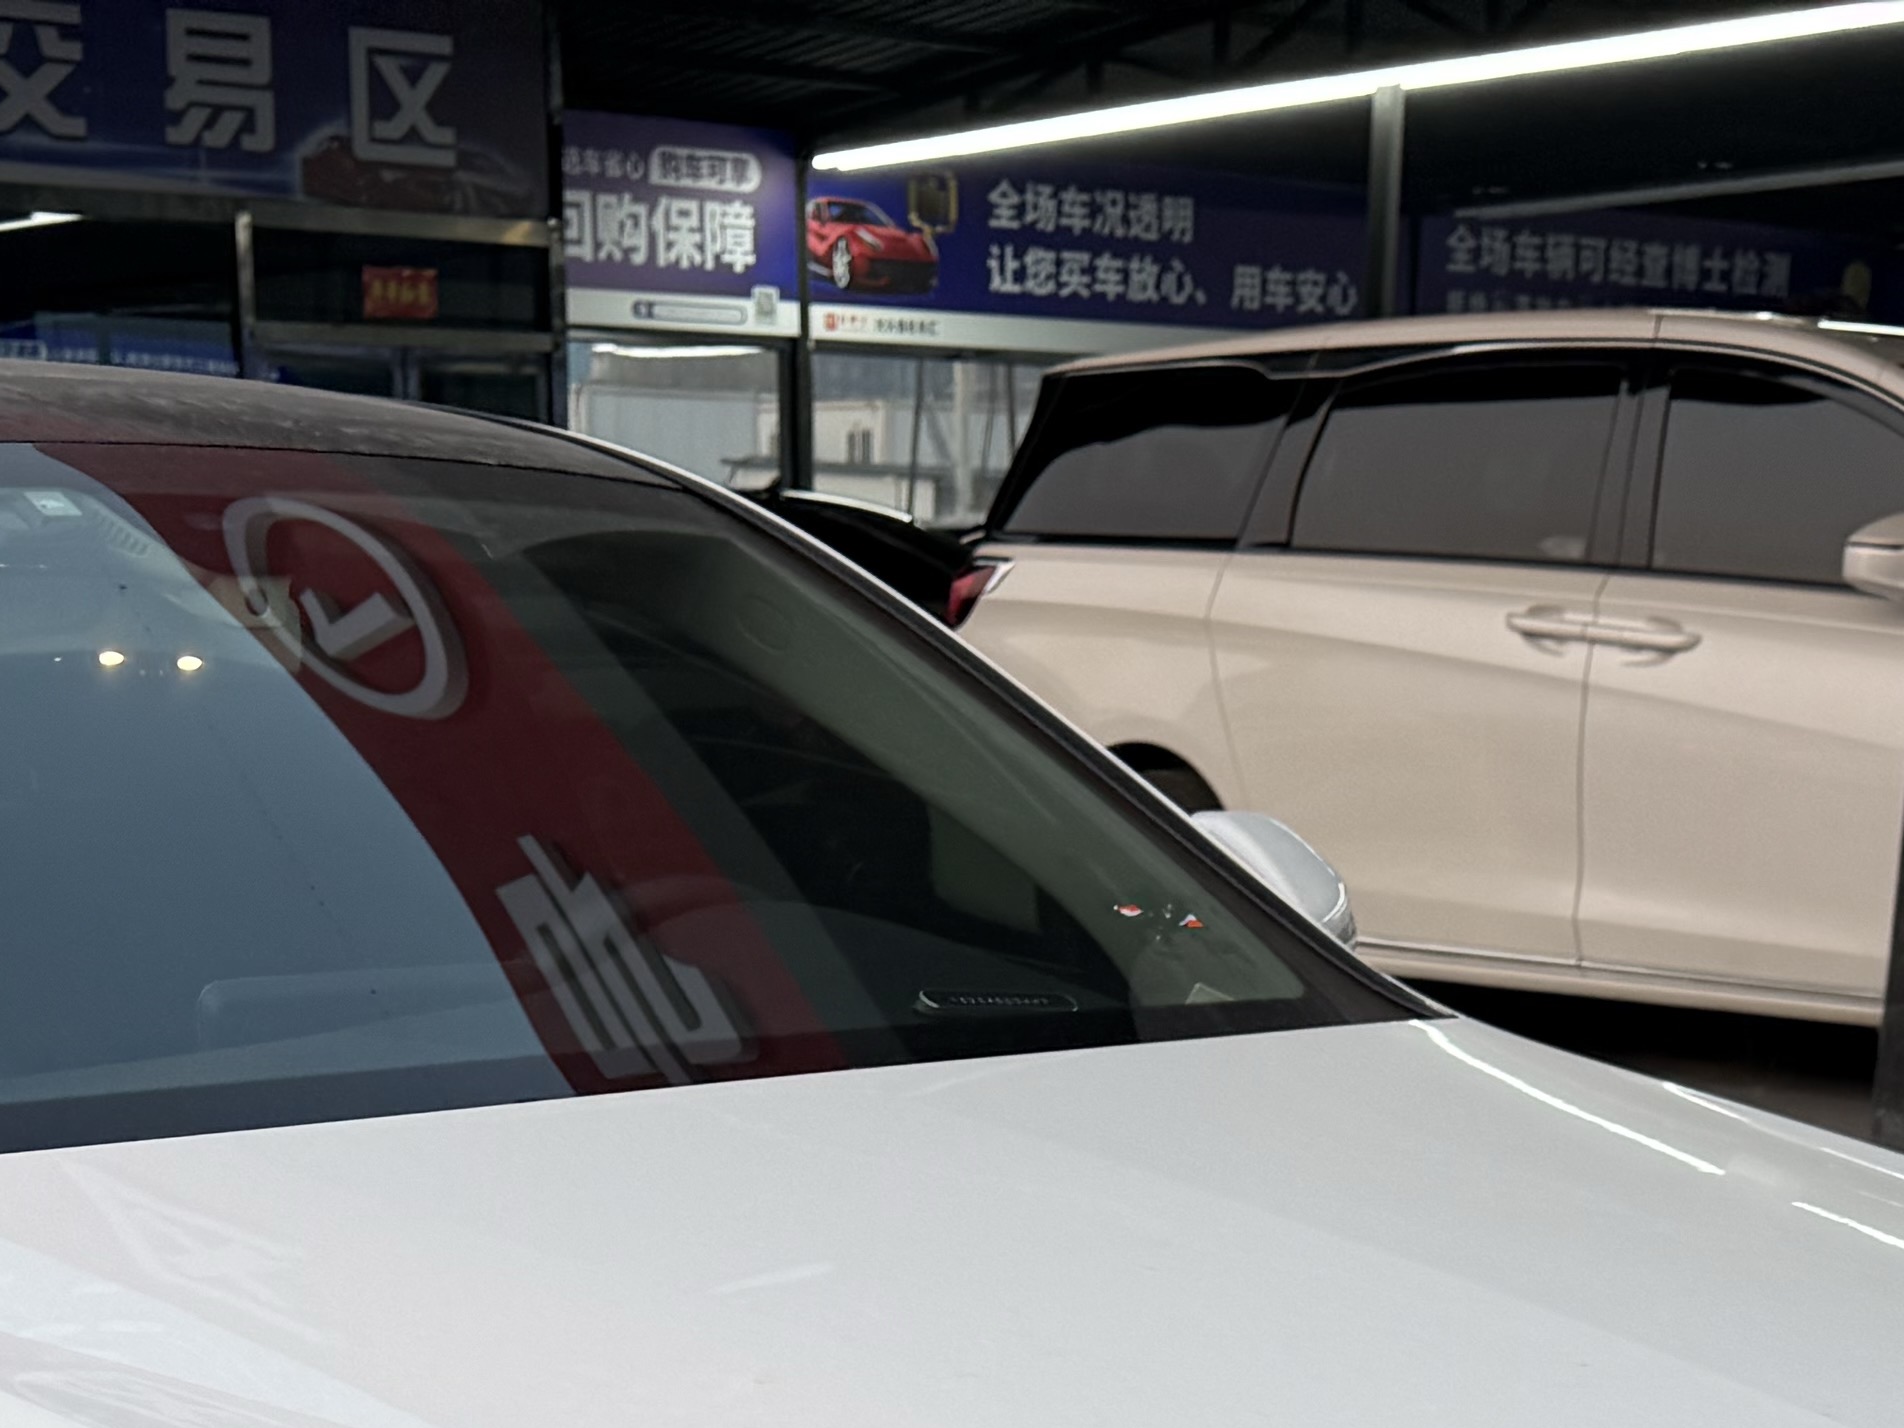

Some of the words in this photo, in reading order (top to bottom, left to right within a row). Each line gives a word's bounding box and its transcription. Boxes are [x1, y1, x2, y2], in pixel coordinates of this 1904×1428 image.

[564, 190, 757, 274] 回购保障
[987, 178, 1196, 244] 全场车况透明
